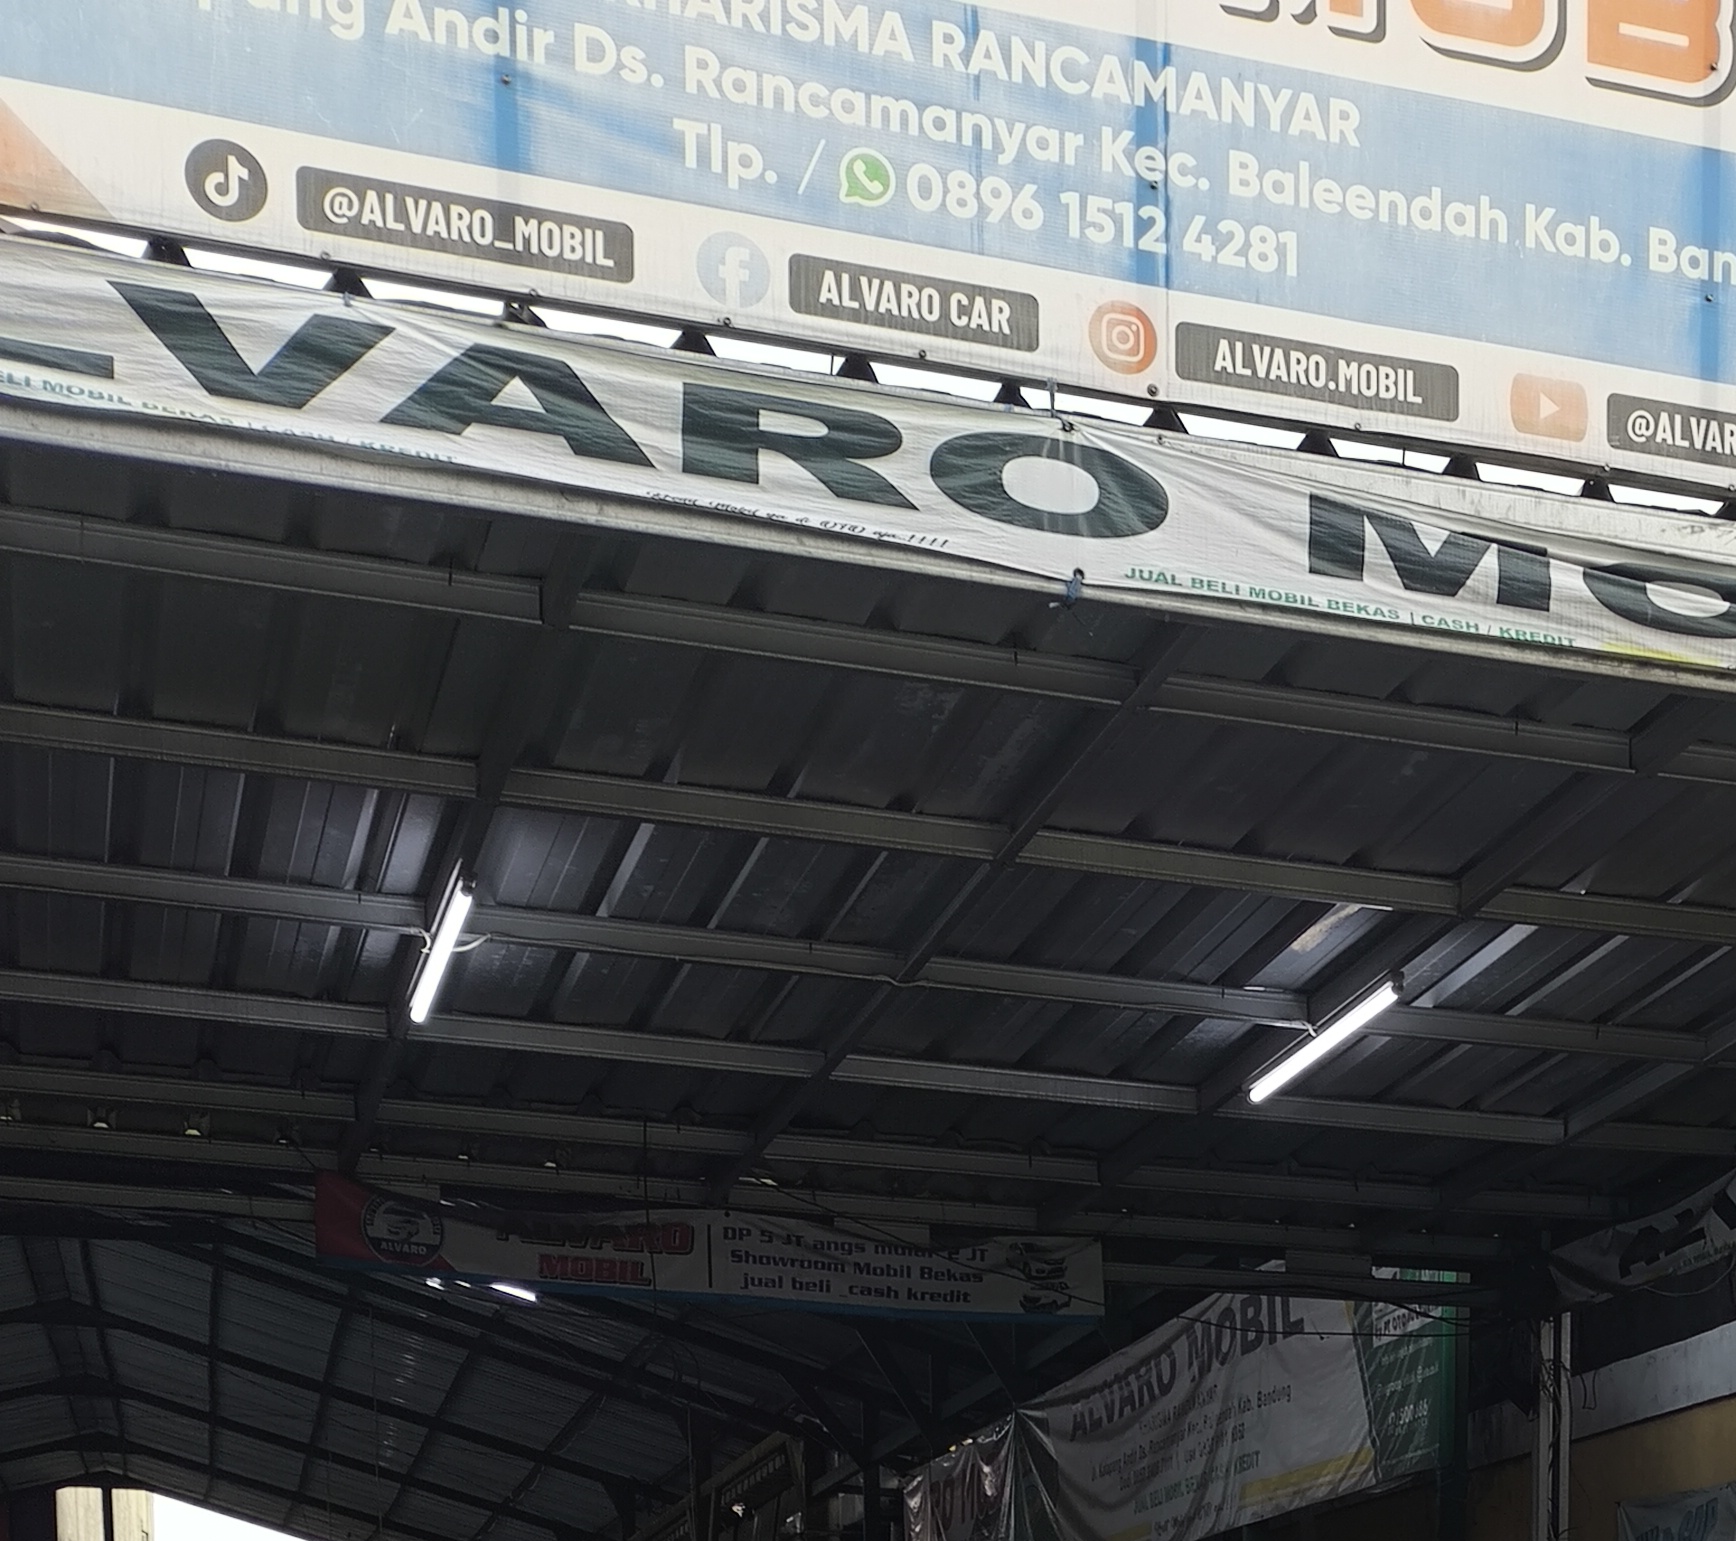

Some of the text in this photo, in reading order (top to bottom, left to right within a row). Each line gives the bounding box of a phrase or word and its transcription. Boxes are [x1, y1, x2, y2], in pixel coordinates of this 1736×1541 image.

[931, 19, 1362, 147] RANCAMANYAR
[385, 0, 552, 64] Andir
[573, 22, 665, 88] Ds.
[684, 44, 1083, 169] Rancamanyar
[1100, 136, 1210, 193] Kec.
[1228, 149, 1507, 244] Baleendah
[1523, 209, 1631, 267] Kab.
[322, 186, 616, 270] @ALVARO_MOBIL
[673, 117, 778, 187] Tlp.
[907, 163, 1044, 231] 0896
[1060, 191, 1165, 256] 1512
[1182, 219, 1300, 278] 4281
[819, 269, 1012, 336] ALVARO CAR
[1213, 337, 1423, 406] ALVARO.MOBIL
[1125, 567, 1183, 587] JUAL
[1190, 577, 1240, 597] BELI
[1248, 587, 1320, 609] MOBIL
[1326, 599, 1401, 620] BEKAS
[1421, 615, 1480, 634] CASH
[538, 1254, 651, 1286] MOBIL
[730, 1249, 985, 1284] Showroom Mobil Bekas
[740, 1272, 784, 1290] jual
[791, 1278, 832, 1294] beli
[906, 1288, 973, 1305] kredit
